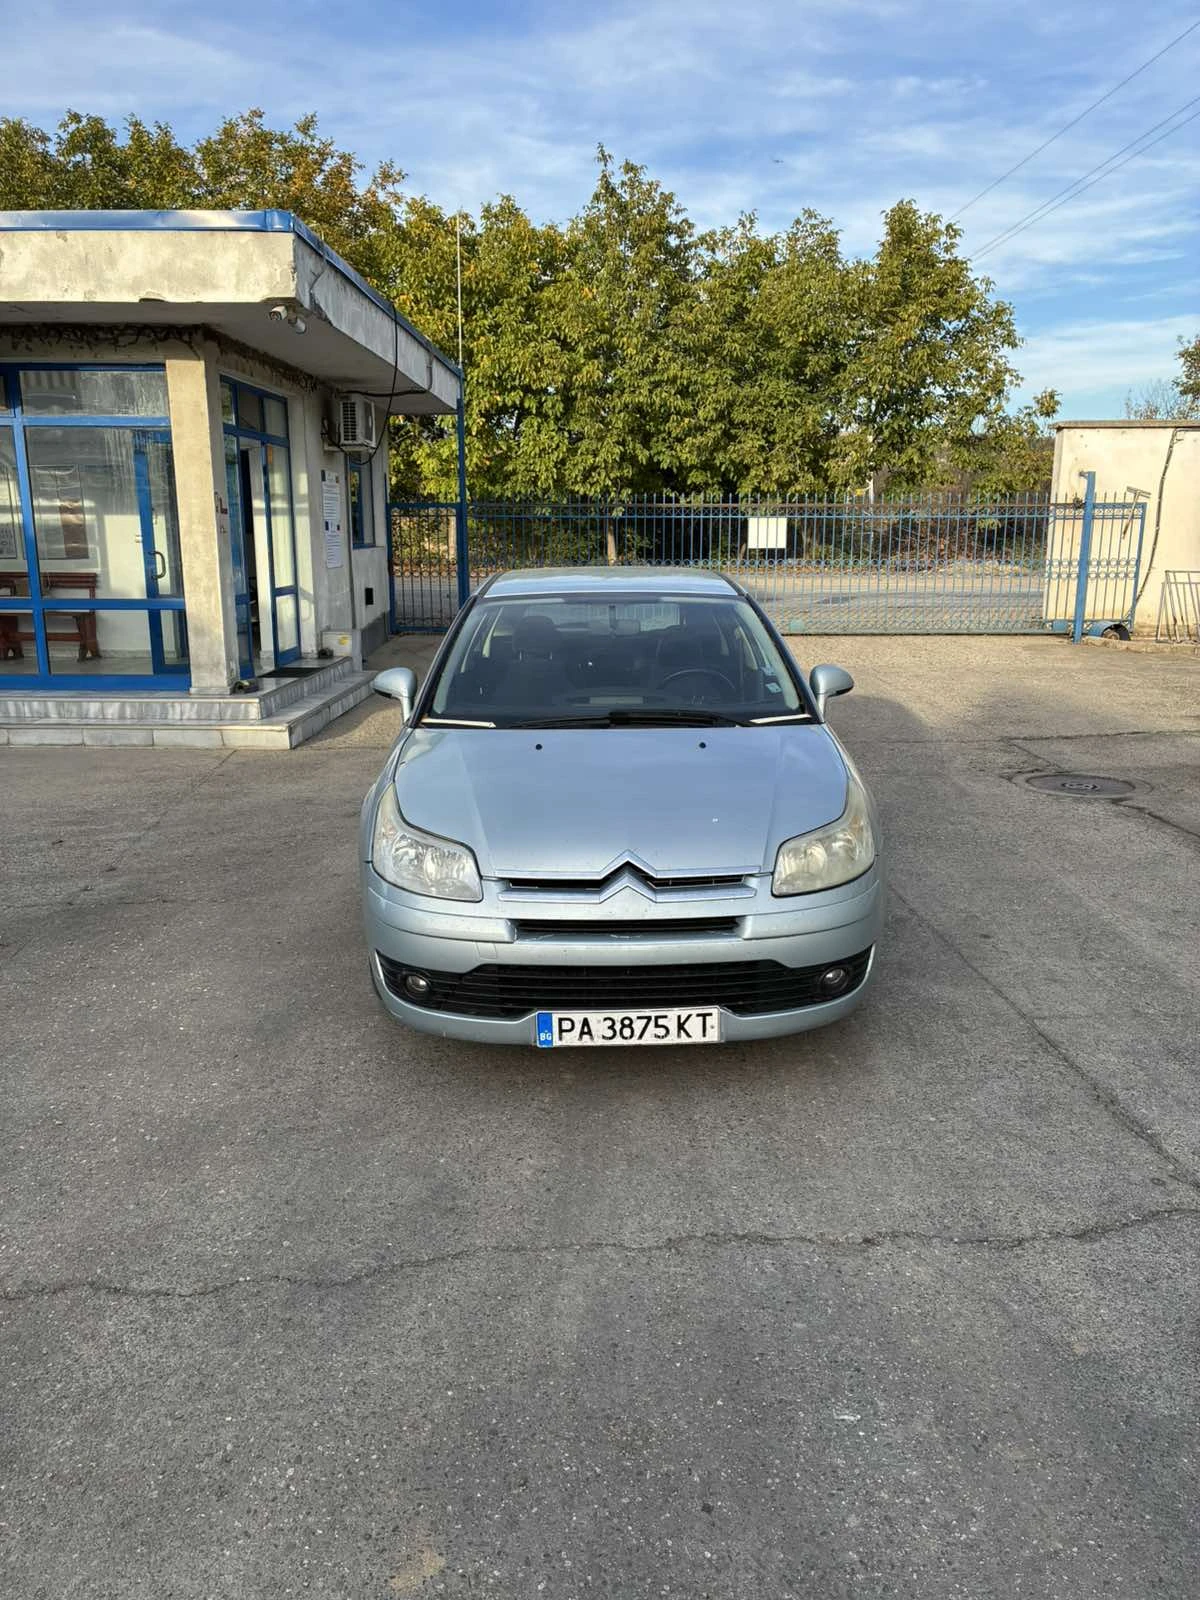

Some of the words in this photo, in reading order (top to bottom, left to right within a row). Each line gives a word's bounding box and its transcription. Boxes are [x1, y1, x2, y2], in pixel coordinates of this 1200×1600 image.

[558, 1017, 594, 1041] PA
[601, 1015, 670, 1041] 3875
[677, 1013, 712, 1038] KT
[540, 1032, 552, 1041] BG
